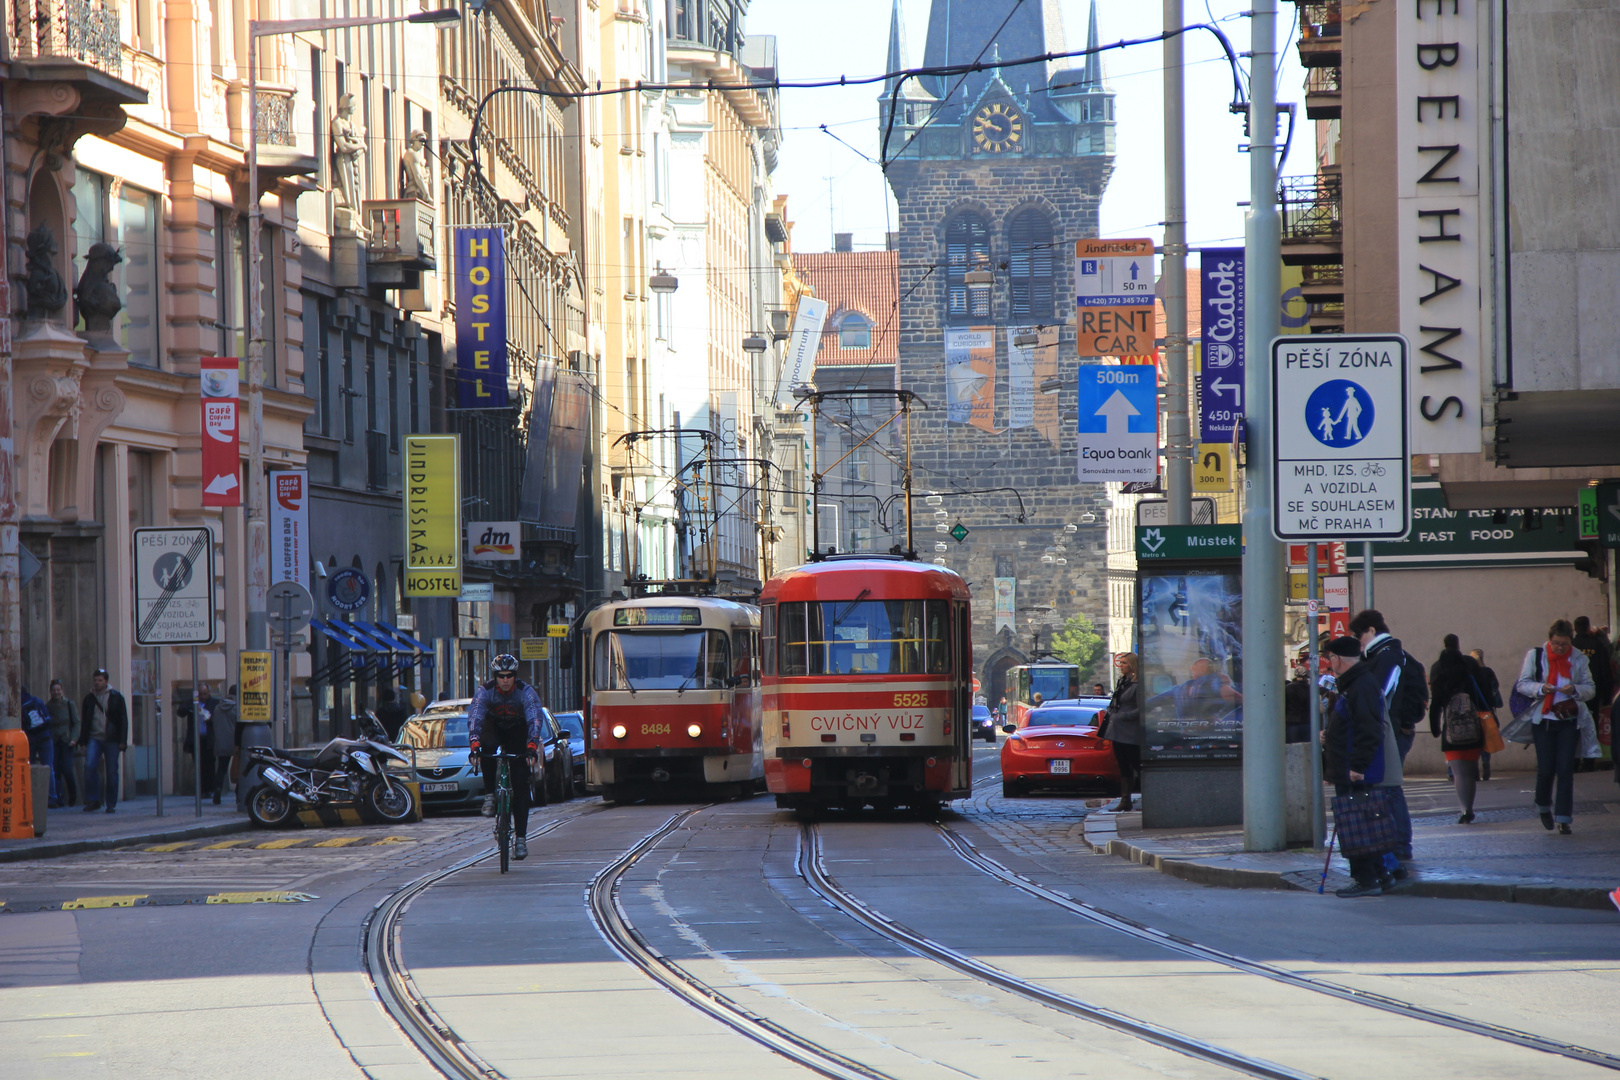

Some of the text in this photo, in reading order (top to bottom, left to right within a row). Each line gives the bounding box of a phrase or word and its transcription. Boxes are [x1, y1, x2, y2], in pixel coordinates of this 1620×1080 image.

[1084, 243, 1146, 253] Jindřišská 7
[1123, 282, 1135, 290] 50
[1208, 260, 1236, 342] Čedok
[469, 238, 491, 398] HOSTEL
[1082, 310, 1152, 333] RENT
[1094, 335, 1138, 353] CAR
[787, 328, 810, 392] Hypocentrum
[1210, 346, 1218, 366] 1920
[1286, 348, 1392, 369] PĚŠÍ ZÓNA
[1096, 371, 1139, 384] 500m
[209, 406, 230, 414] Café
[1208, 410, 1243, 420] 450 m
[1082, 447, 1152, 461] Equa bank
[1304, 482, 1378, 494] A VOZIDLA
[411, 442, 428, 553] JINDŘIŠSKÁ
[1145, 506, 1167, 518] PĚŠ
[1288, 500, 1395, 512] SE SOUHLASEM
[1299, 516, 1384, 530] MČ PRAHA 1
[142, 534, 168, 546] PĚŠÍ
[480, 526, 510, 545] dm
[1419, 531, 1456, 542] FAST
[1471, 530, 1514, 540] FOOD
[411, 554, 453, 564] PASÁŽ
[408, 578, 458, 590] HOSTEL
[893, 694, 928, 707] 5525
[810, 711, 924, 731] CVIČNÝ VŮZ
[641, 724, 670, 734] 8484
[4, 744, 14, 794] SCOOTER
[2, 808, 11, 832] BIKE
